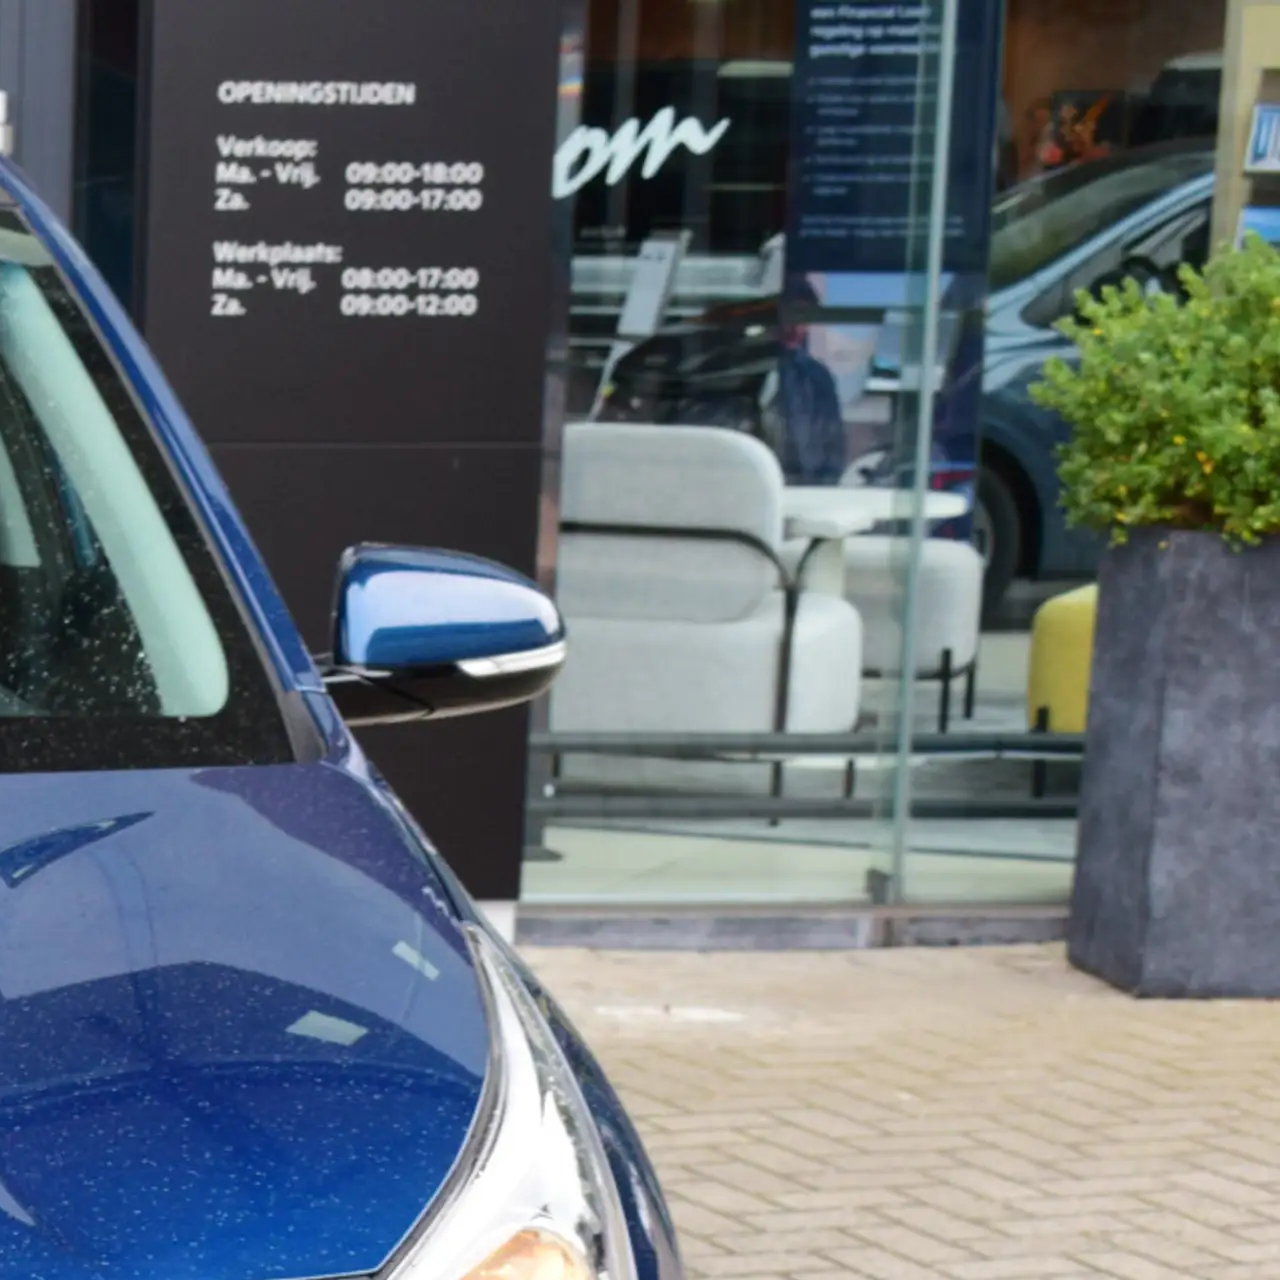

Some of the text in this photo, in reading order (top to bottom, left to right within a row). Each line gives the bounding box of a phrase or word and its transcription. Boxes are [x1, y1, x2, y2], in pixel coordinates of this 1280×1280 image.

[216, 134, 318, 161] Verkoop:
[215, 162, 257, 184] Ma.
[274, 162, 321, 188] Vrij.
[214, 188, 483, 211] Za. 09:00-17:00
[213, 241, 343, 266] Werkplaats:
[212, 267, 254, 290] Ma.
[270, 267, 317, 294] Vrij.
[211, 293, 247, 316] Za.
